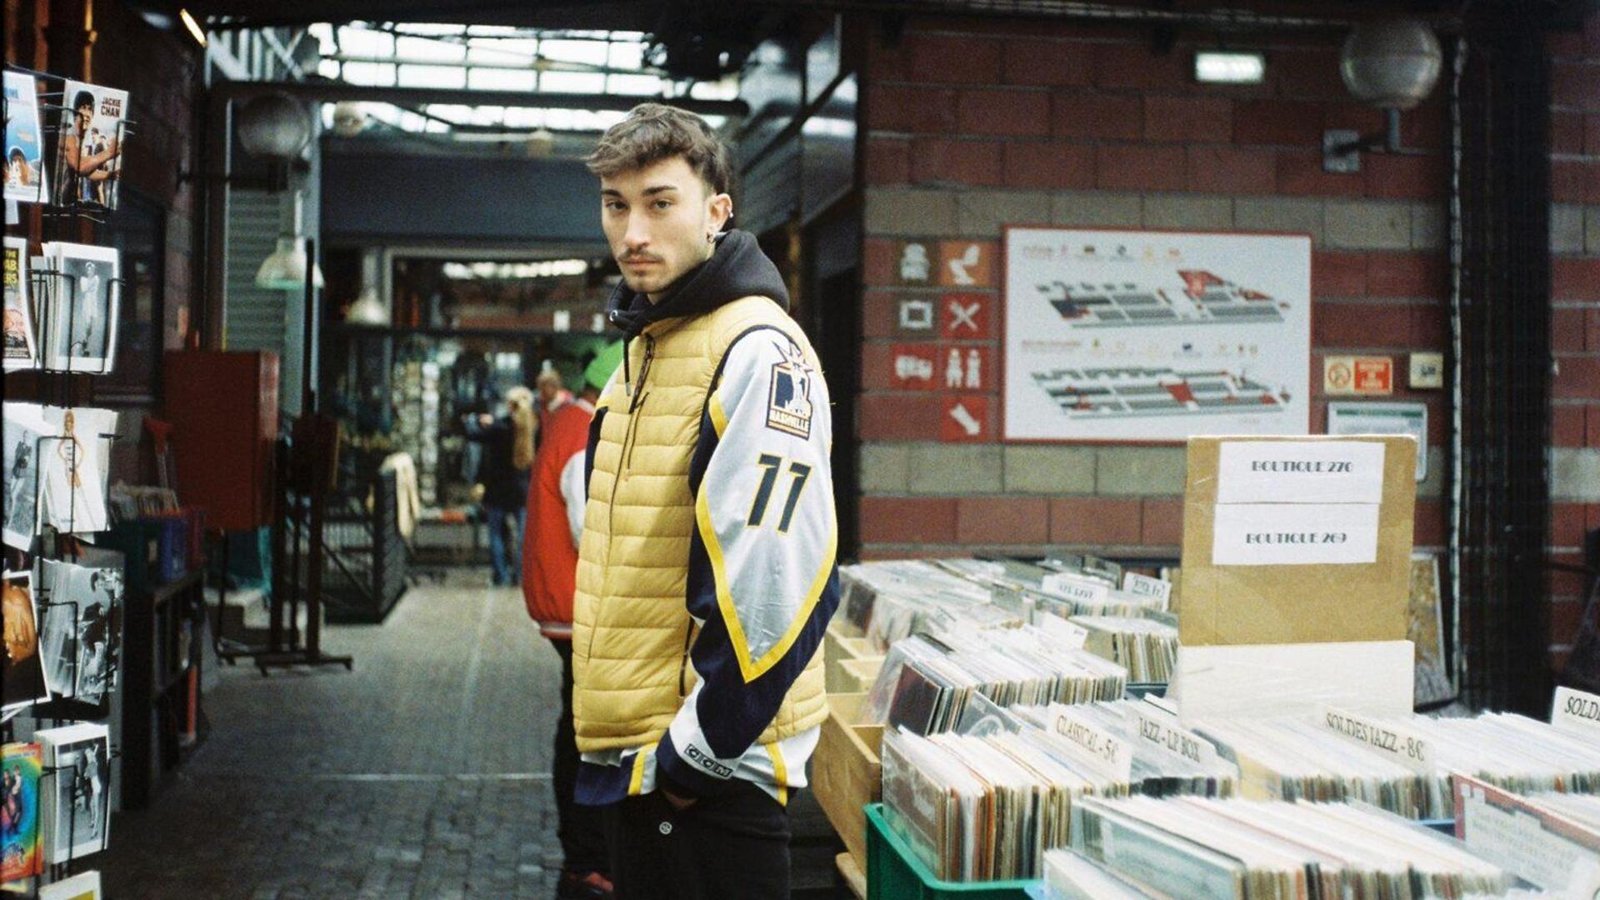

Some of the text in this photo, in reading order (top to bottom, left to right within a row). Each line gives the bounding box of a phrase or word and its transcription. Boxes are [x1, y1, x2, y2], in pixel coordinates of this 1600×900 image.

[100, 105, 120, 118] CHAN
[101, 97, 122, 107] JACKIE
[1252, 460, 1354, 473] BOUTIQUE 270
[1246, 532, 1348, 545] BOUTIQUE 269
[1056, 714, 1099, 754] CLASSICAL
[1139, 716, 1161, 744] JAZZ
[1167, 729, 1182, 753] LP
[1182, 737, 1201, 763] BOX
[1325, 712, 1369, 741] SOLDES
[1369, 727, 1398, 754] JAZZ
[687, 746, 732, 778] CCM
